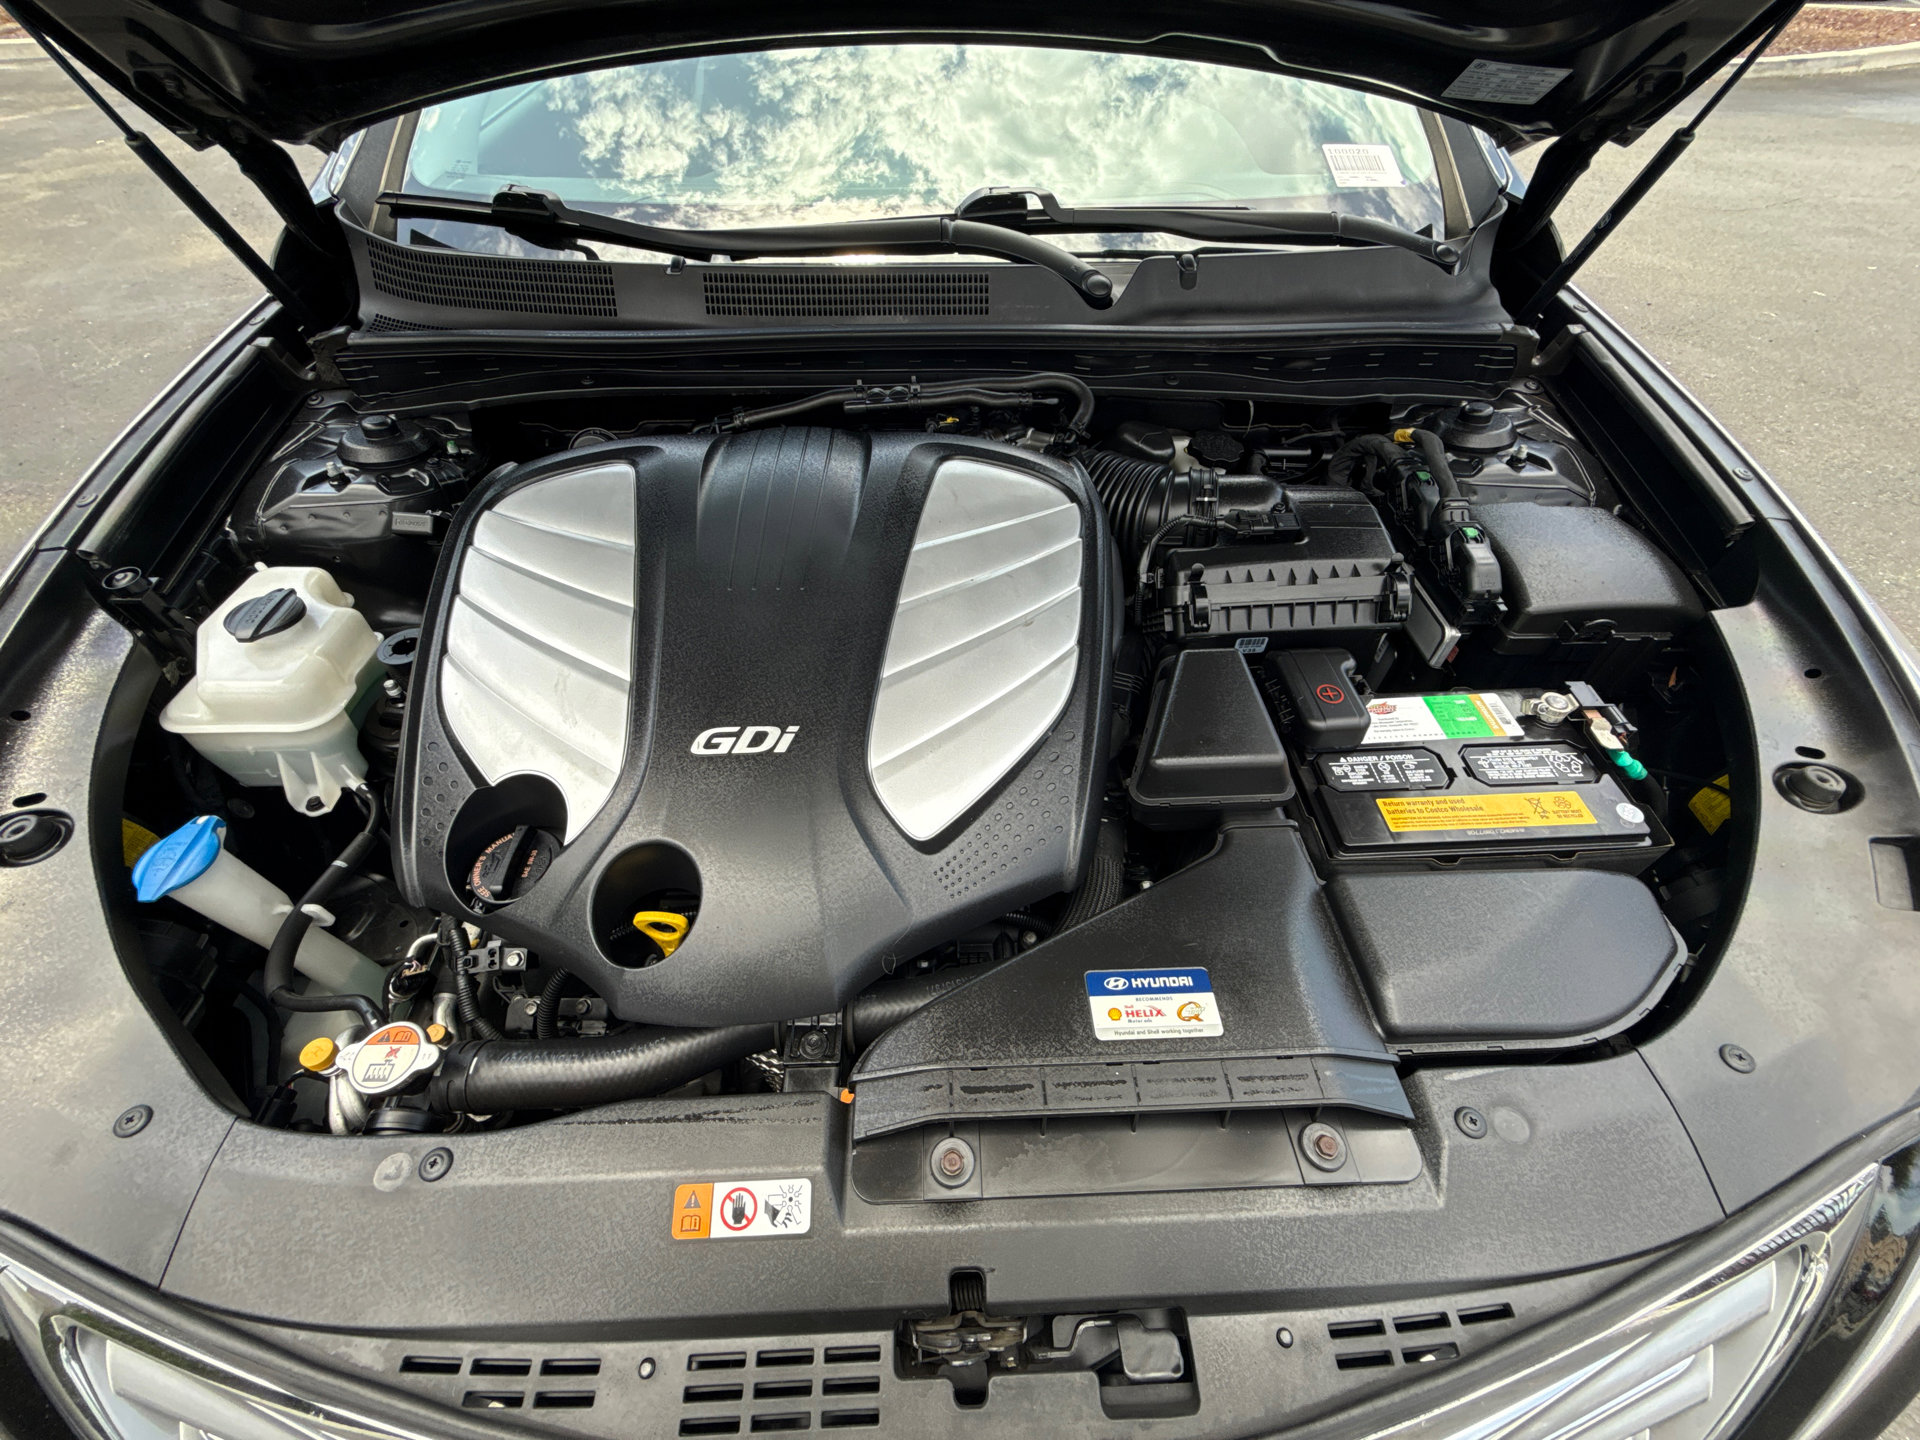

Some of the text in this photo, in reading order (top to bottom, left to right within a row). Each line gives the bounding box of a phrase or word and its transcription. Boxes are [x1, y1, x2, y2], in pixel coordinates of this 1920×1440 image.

[690, 725, 800, 755] GDi
[1385, 753, 1414, 761] POISON
[1406, 799, 1435, 807] warranty
[1386, 807, 1416, 815] batteries
[1425, 806, 1449, 814] Costco
[1449, 805, 1484, 813] Wholesale
[485, 833, 515, 854] MANUA
[1131, 976, 1194, 988] HYUNDAI
[1125, 1008, 1165, 1018] HELIX
[1161, 1027, 1182, 1035] working
[1183, 1027, 1204, 1035] together
